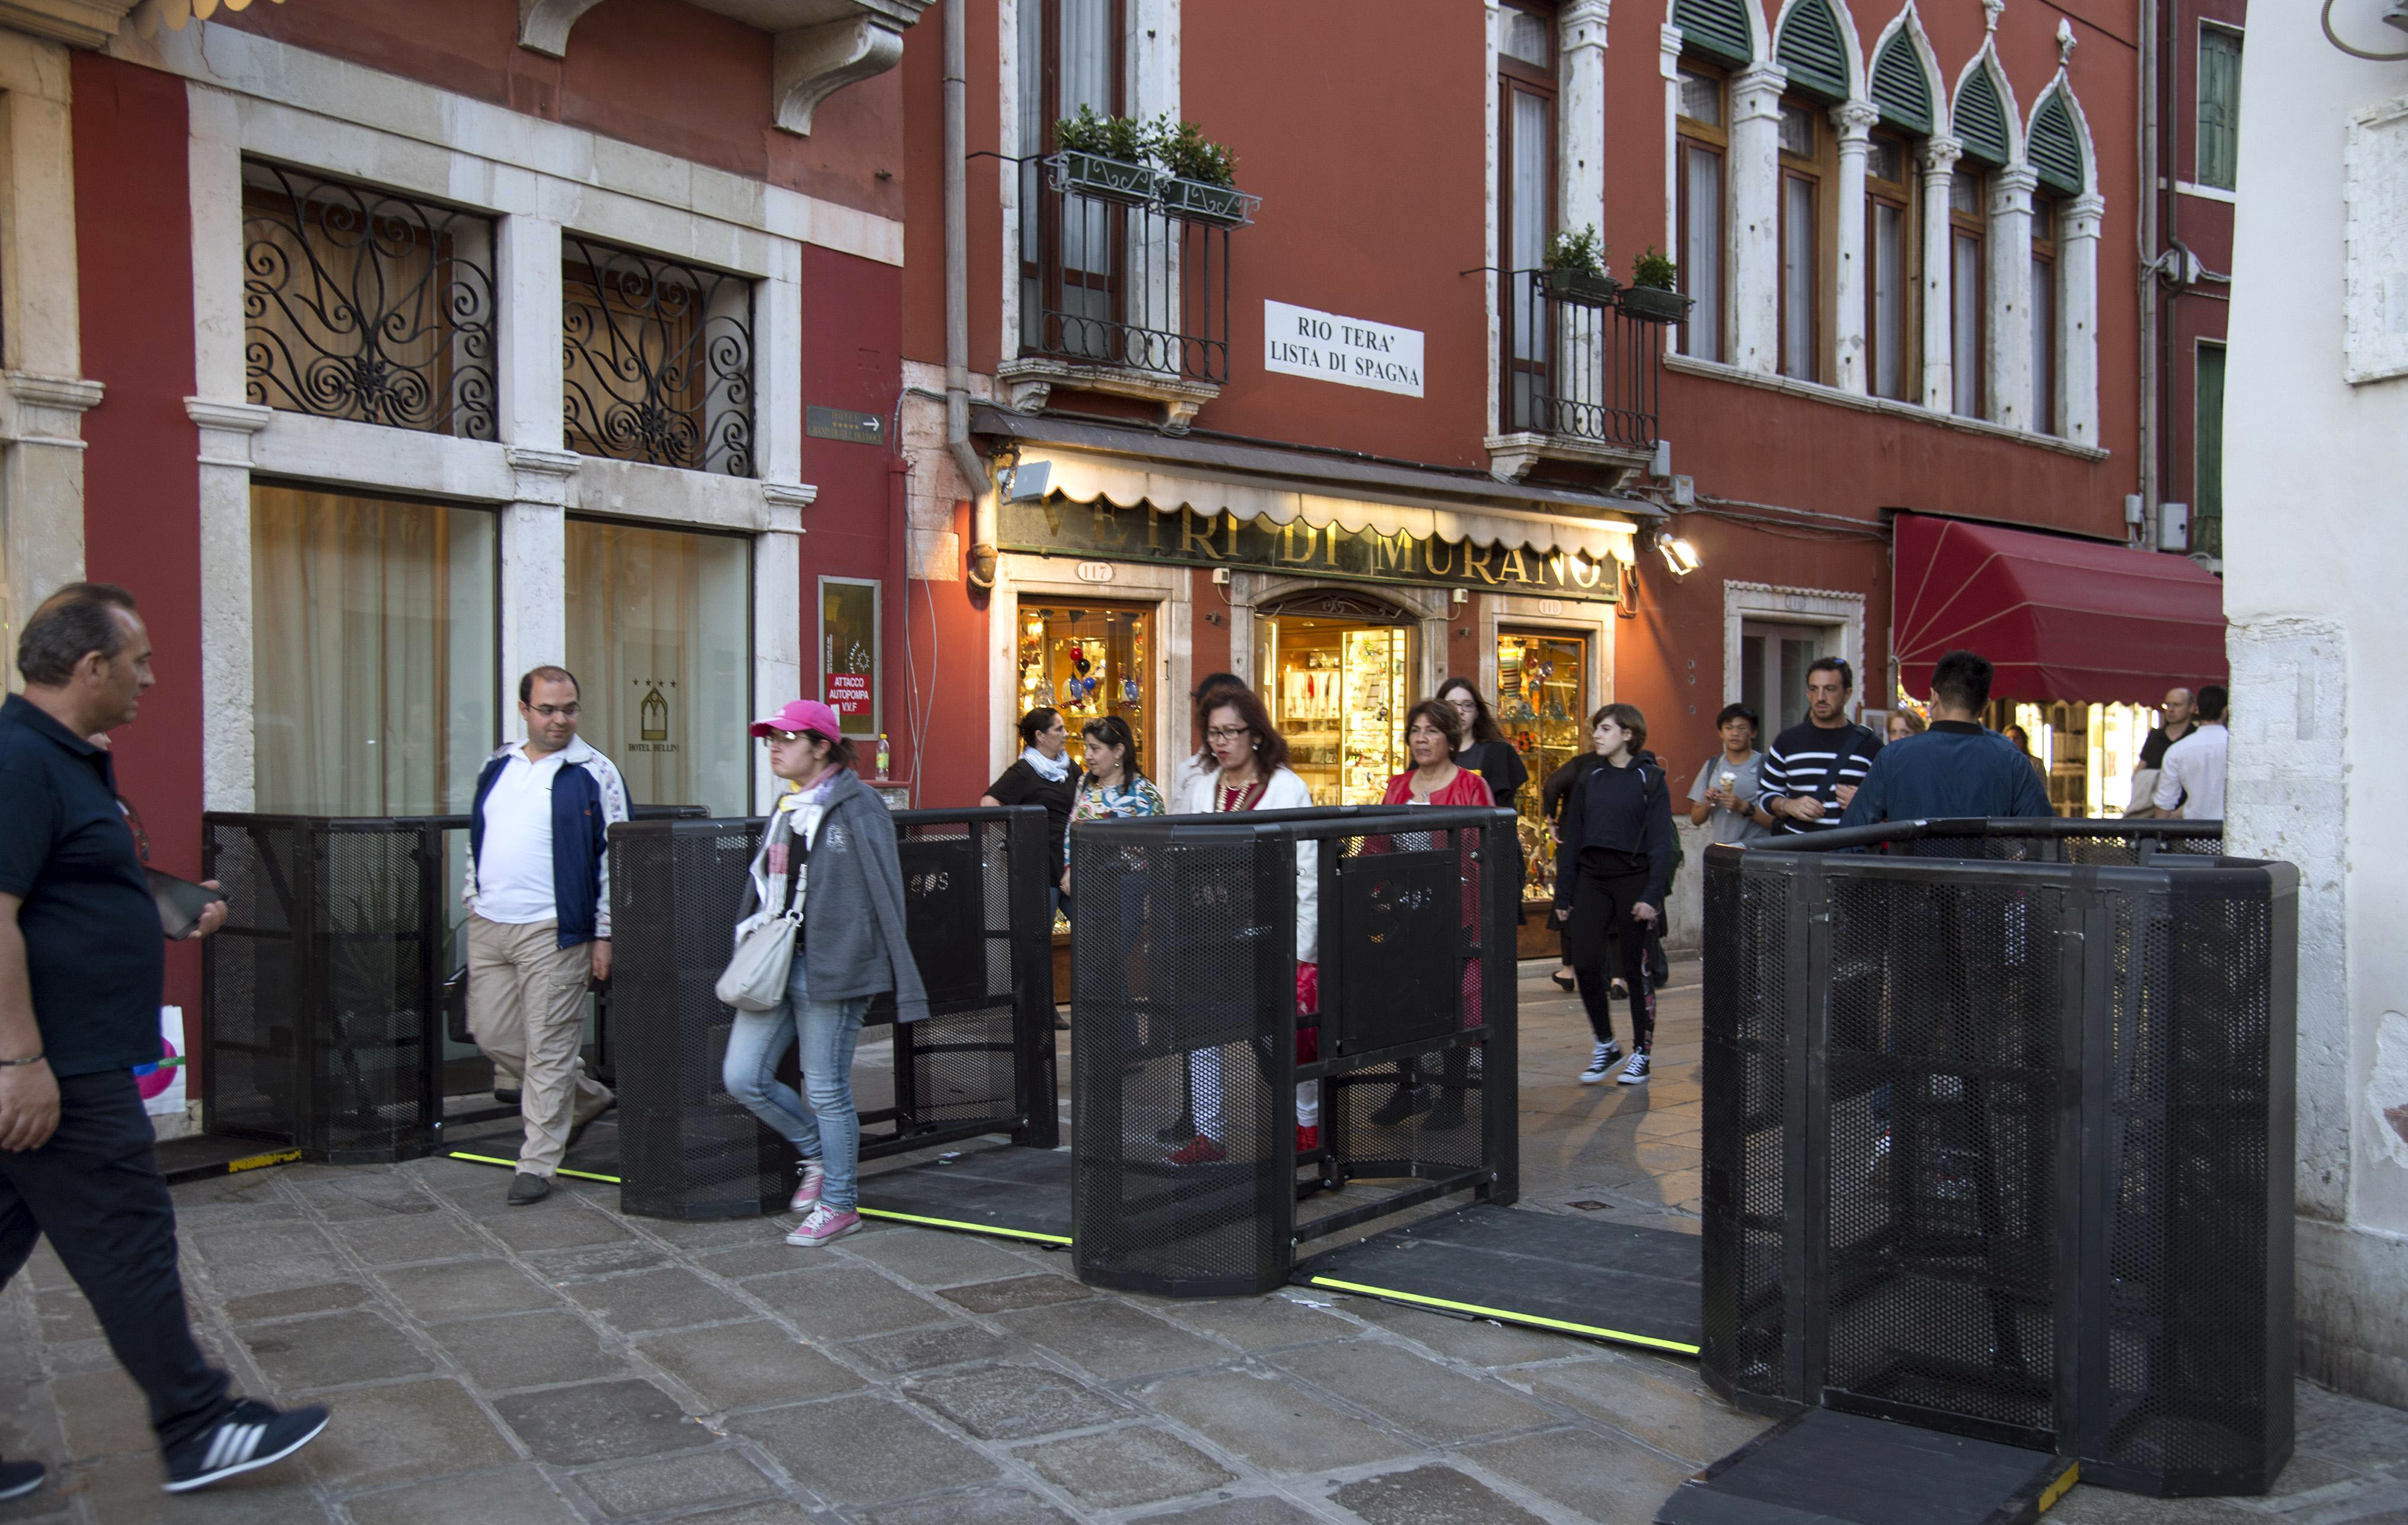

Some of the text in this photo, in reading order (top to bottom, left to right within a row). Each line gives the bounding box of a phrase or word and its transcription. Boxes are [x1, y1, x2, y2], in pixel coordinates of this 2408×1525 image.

[1298, 316, 1395, 353] RIO TERA'
[1271, 340, 1420, 387] LISTA DI SPAGNA
[831, 411, 858, 420] HOTEL
[1375, 528, 1602, 589] MURANO
[1085, 565, 1106, 579] 117
[1543, 601, 1559, 613] 118
[834, 677, 864, 688] ATTACCO
[829, 689, 869, 700] AUTOPOMPA
[628, 744, 651, 752] HOTEL
